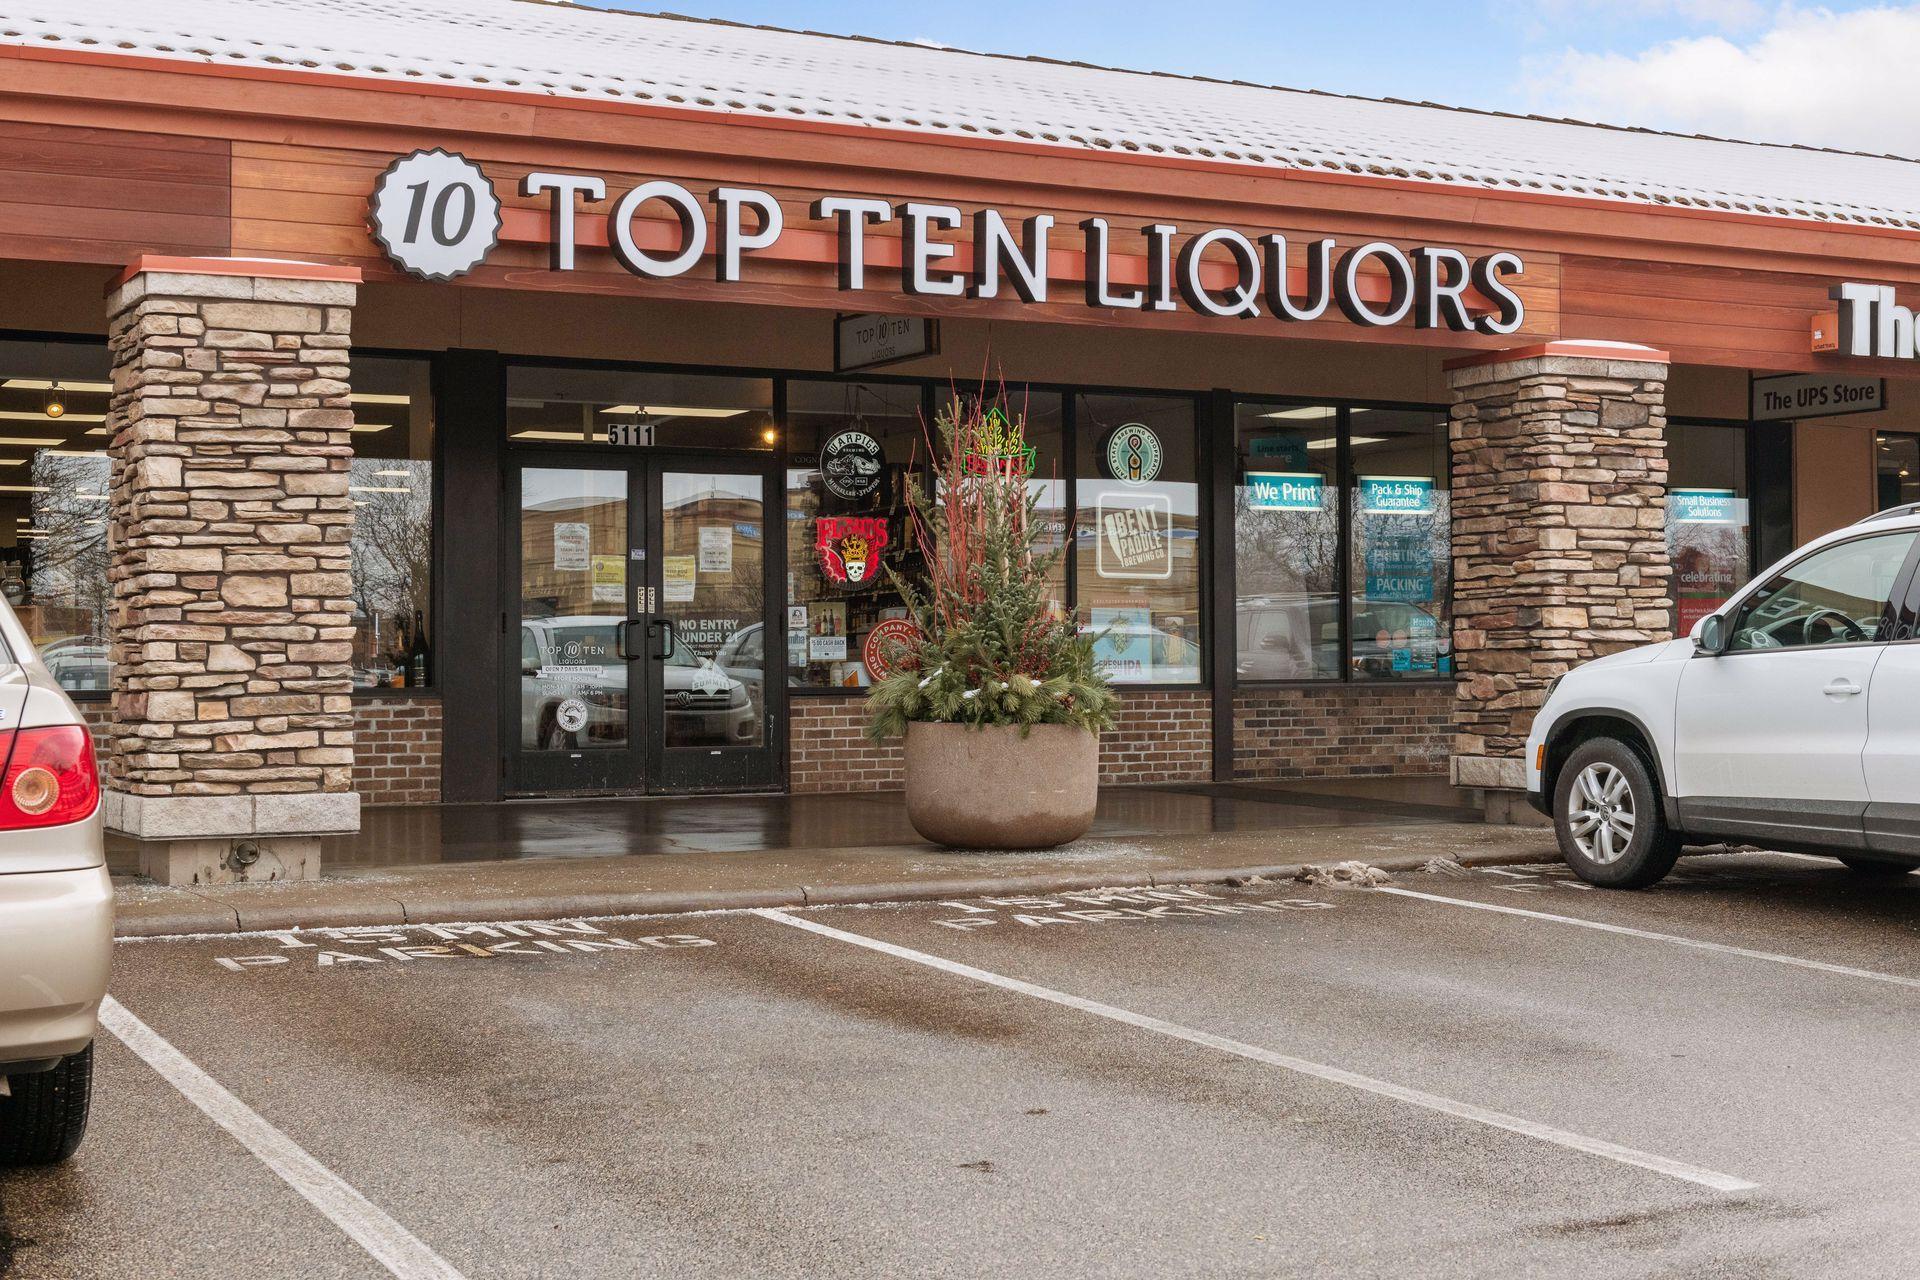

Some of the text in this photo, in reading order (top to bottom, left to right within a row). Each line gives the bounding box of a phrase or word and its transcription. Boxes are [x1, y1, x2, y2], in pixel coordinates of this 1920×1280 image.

[401, 178, 476, 247] 10
[518, 172, 1525, 335] TOP TEN LIQUORS
[856, 318, 911, 345] TOP 10 TEN
[871, 346, 896, 360] LIQUORS
[1764, 384, 1875, 411] The UPS Store
[608, 424, 654, 446] 5111
[1117, 428, 1146, 440] BREWING
[828, 433, 879, 456] WARPIGS
[1142, 435, 1159, 480] COOPERATIVE
[1114, 466, 1128, 480] FAIR
[1254, 482, 1316, 501] We Print
[1371, 483, 1423, 498] Pack & Ship
[1376, 495, 1420, 507] Guarantee
[1677, 495, 1731, 506] Small Business
[1688, 506, 1722, 517] Solutions
[1114, 504, 1158, 538] BENT
[1120, 530, 1163, 557] PADDLE
[1124, 551, 1155, 567] BREWING
[1376, 578, 1423, 591] PACKING
[1680, 571, 1733, 585] celebrating
[679, 619, 738, 630] NO ENTRY
[1412, 618, 1434, 626] Hours
[681, 631, 738, 643] UNDER 21
[541, 645, 605, 655] TOP 10 TEN
[693, 678, 728, 688] SUMMIT
[930, 899, 1338, 932] PARKING
[214, 933, 718, 972] PARKING
